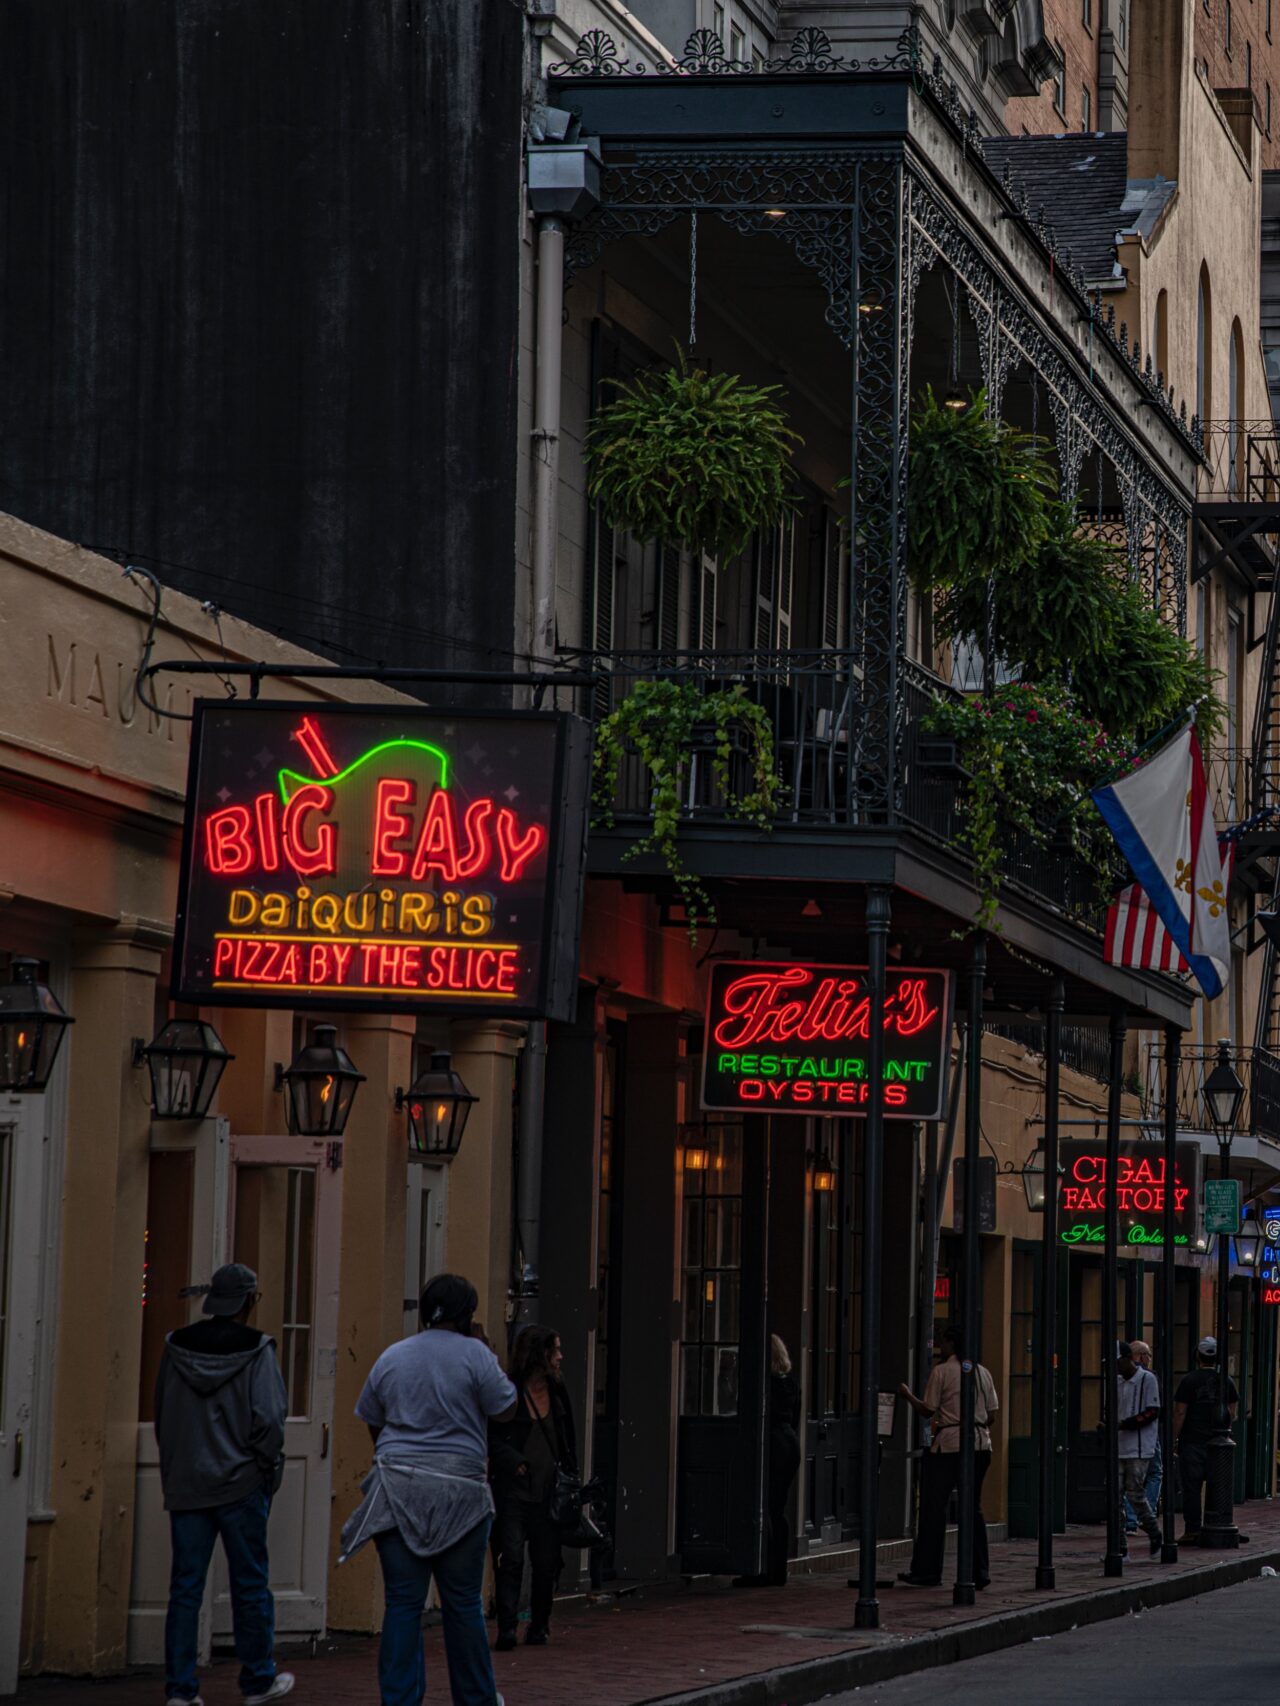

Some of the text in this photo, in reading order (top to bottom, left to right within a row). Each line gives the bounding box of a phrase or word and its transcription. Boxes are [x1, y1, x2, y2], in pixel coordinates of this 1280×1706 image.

[47, 634, 193, 745] MAUM
[204, 777, 546, 883] BIG EASY
[213, 937, 520, 993] PIZZA BY THE SLICE
[716, 1052, 931, 1082] RESTAURNT
[1061, 1224, 1189, 1246] Ne Orlens
